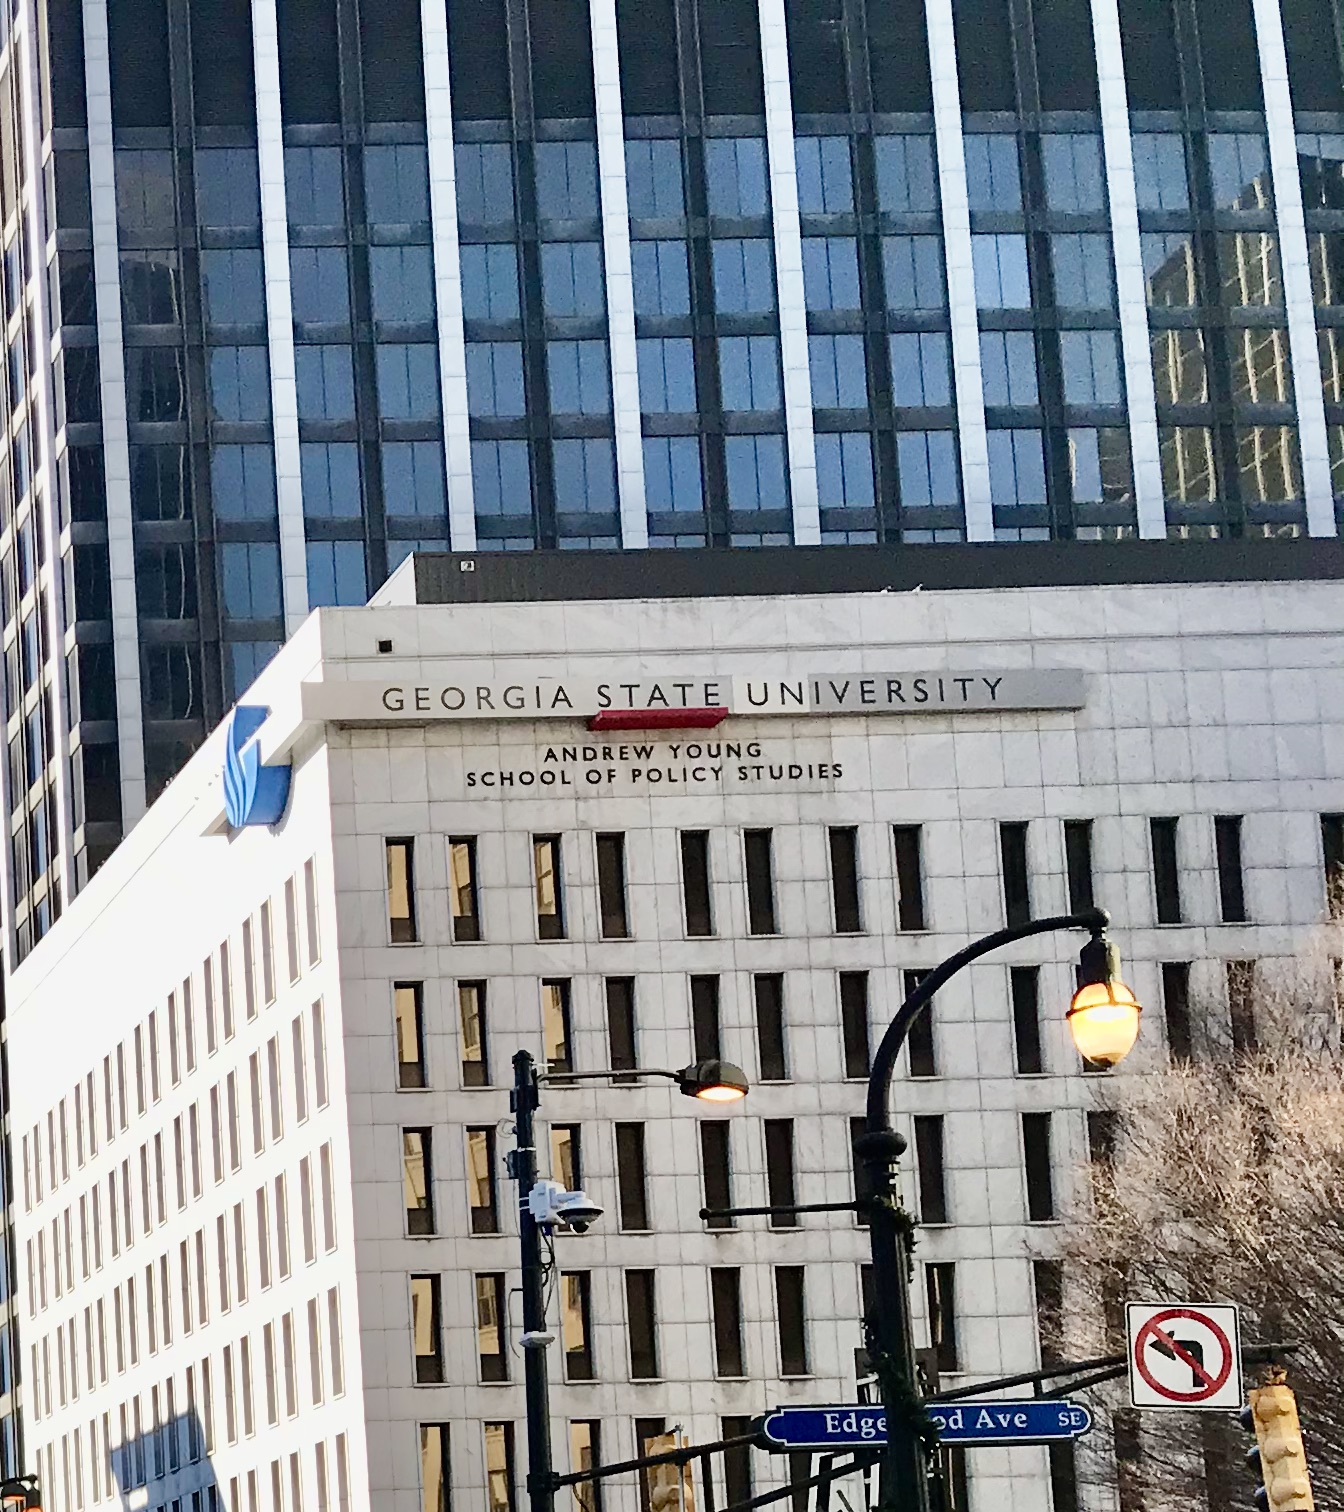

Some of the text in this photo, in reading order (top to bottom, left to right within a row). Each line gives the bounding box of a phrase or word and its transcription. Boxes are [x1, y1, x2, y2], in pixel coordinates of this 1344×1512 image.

[382, 677, 1004, 712] GEORGIA STATE UNIVERSITY
[543, 742, 762, 763] ANDREW YOUNG
[466, 763, 844, 788] SCHOOL OF POLICY STUDIES
[823, 1408, 1082, 1438] Edgeod Ave SE
